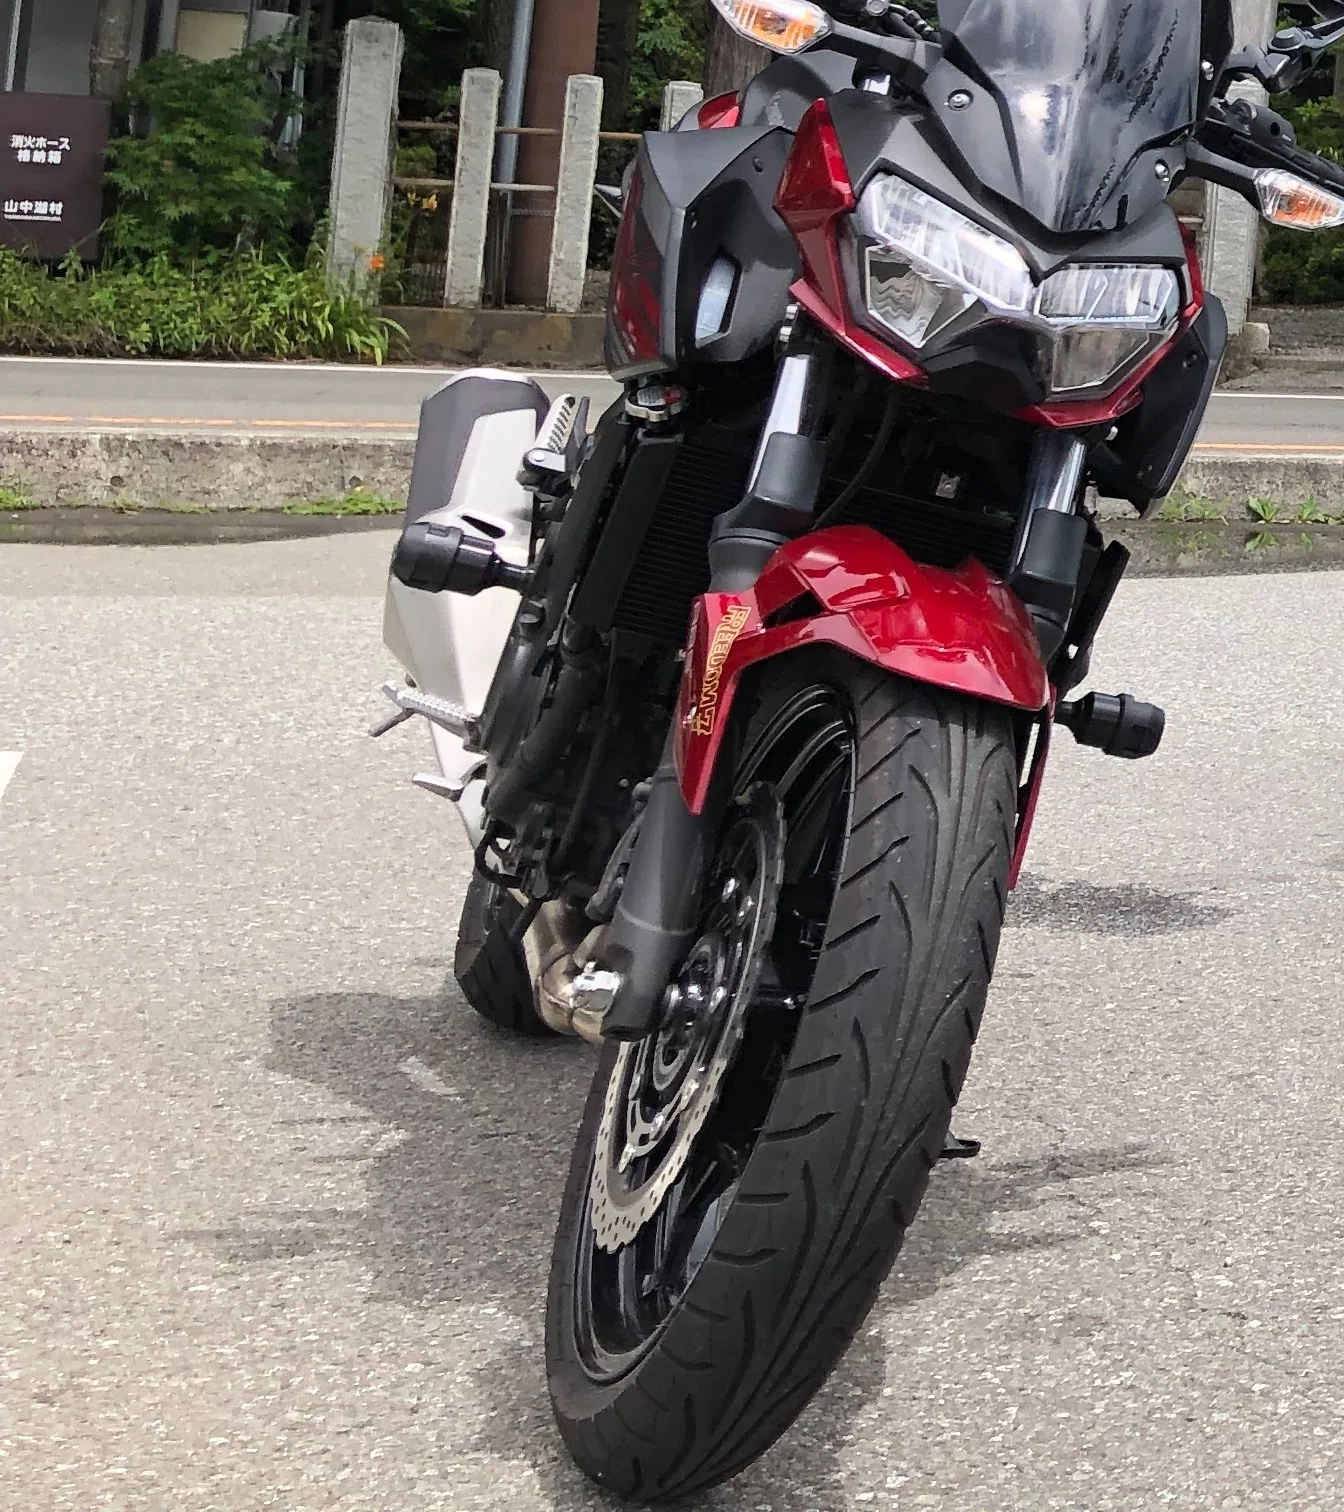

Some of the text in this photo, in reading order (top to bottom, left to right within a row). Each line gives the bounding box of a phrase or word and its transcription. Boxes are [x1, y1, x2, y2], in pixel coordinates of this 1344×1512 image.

[11, 134, 71, 150] 消火ホース
[17, 149, 62, 164] 格納箱
[4, 199, 63, 215] 山中湖村
